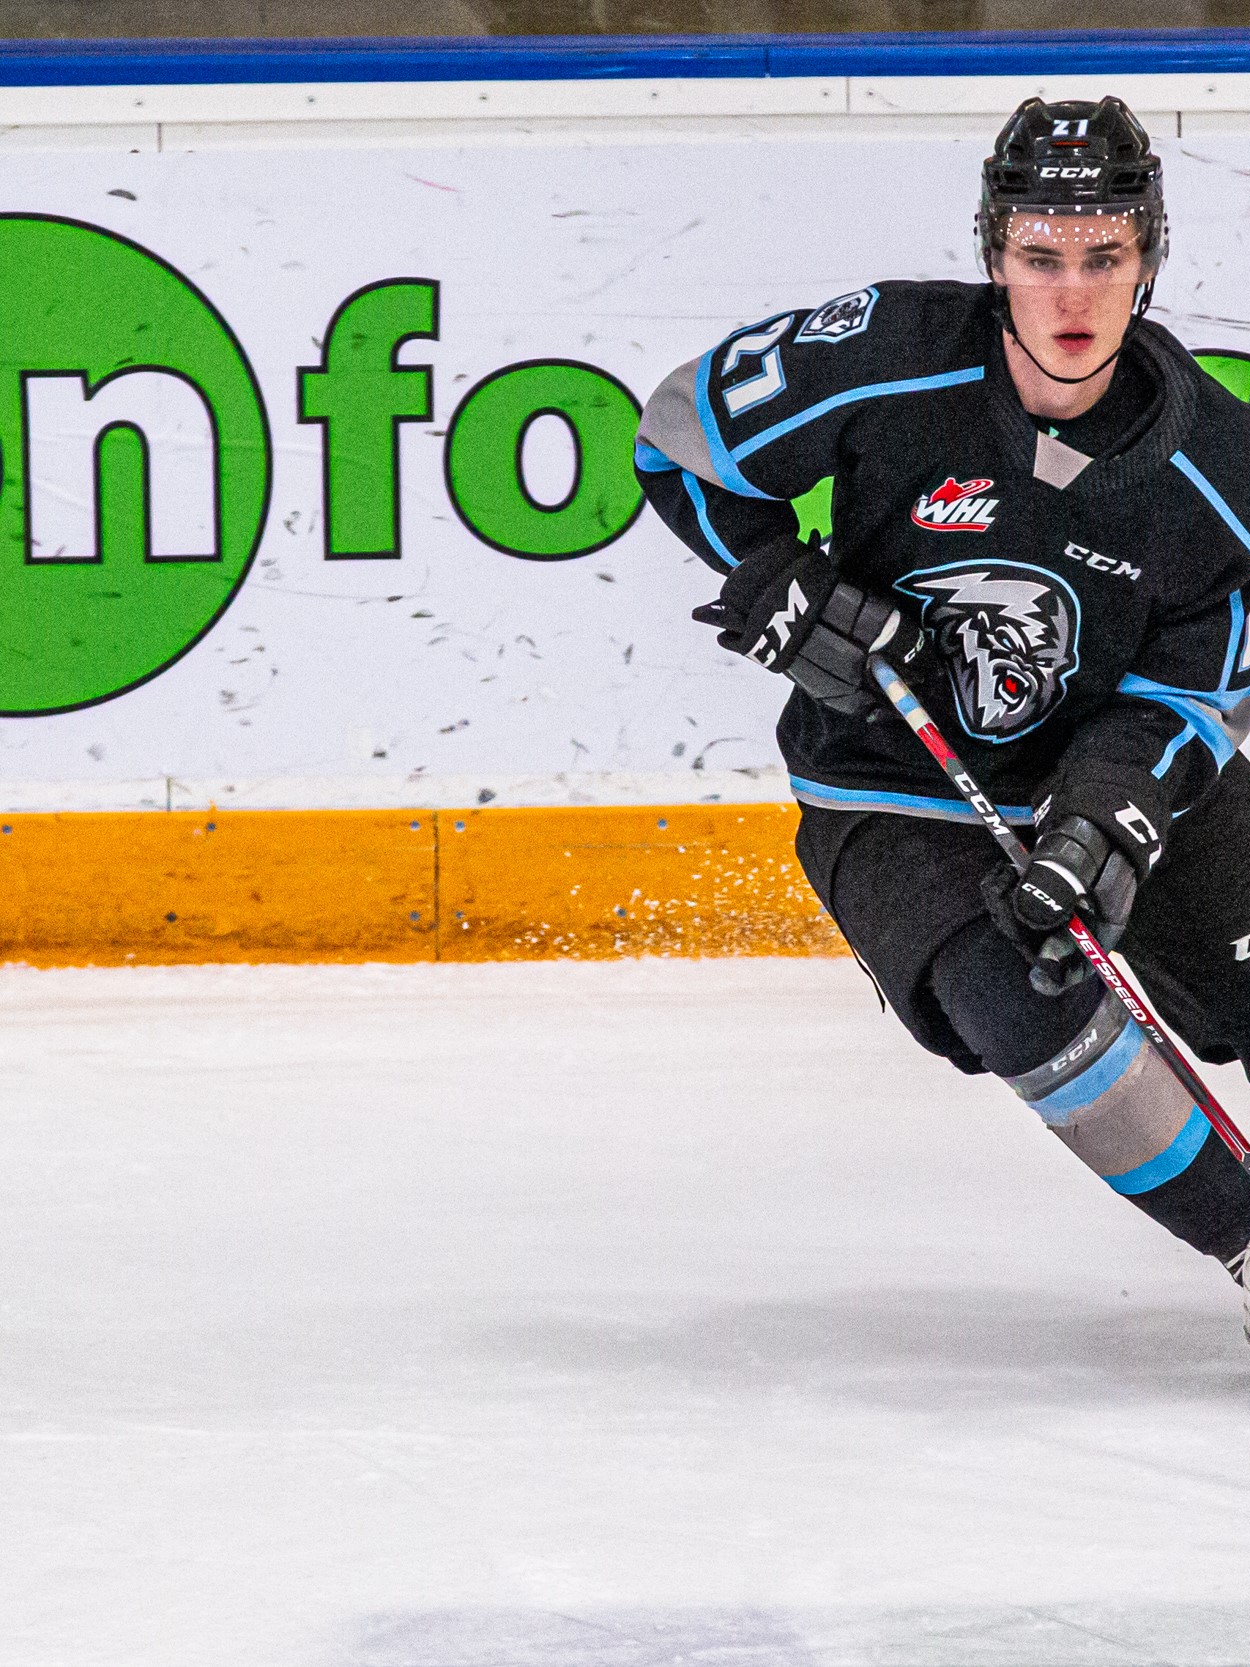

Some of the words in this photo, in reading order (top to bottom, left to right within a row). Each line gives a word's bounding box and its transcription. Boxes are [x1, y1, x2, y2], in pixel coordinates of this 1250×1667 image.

[1051, 118, 1088, 137] 21
[1039, 166, 1102, 179] CCM
[297, 277, 645, 561] fo
[915, 493, 1001, 526] WHL
[1064, 540, 1143, 581] CCM
[953, 771, 1009, 837] CCM
[1021, 882, 1064, 912] CCM
[1068, 927, 1148, 1023] JETSPEED
[1051, 1028, 1098, 1072] CCM
